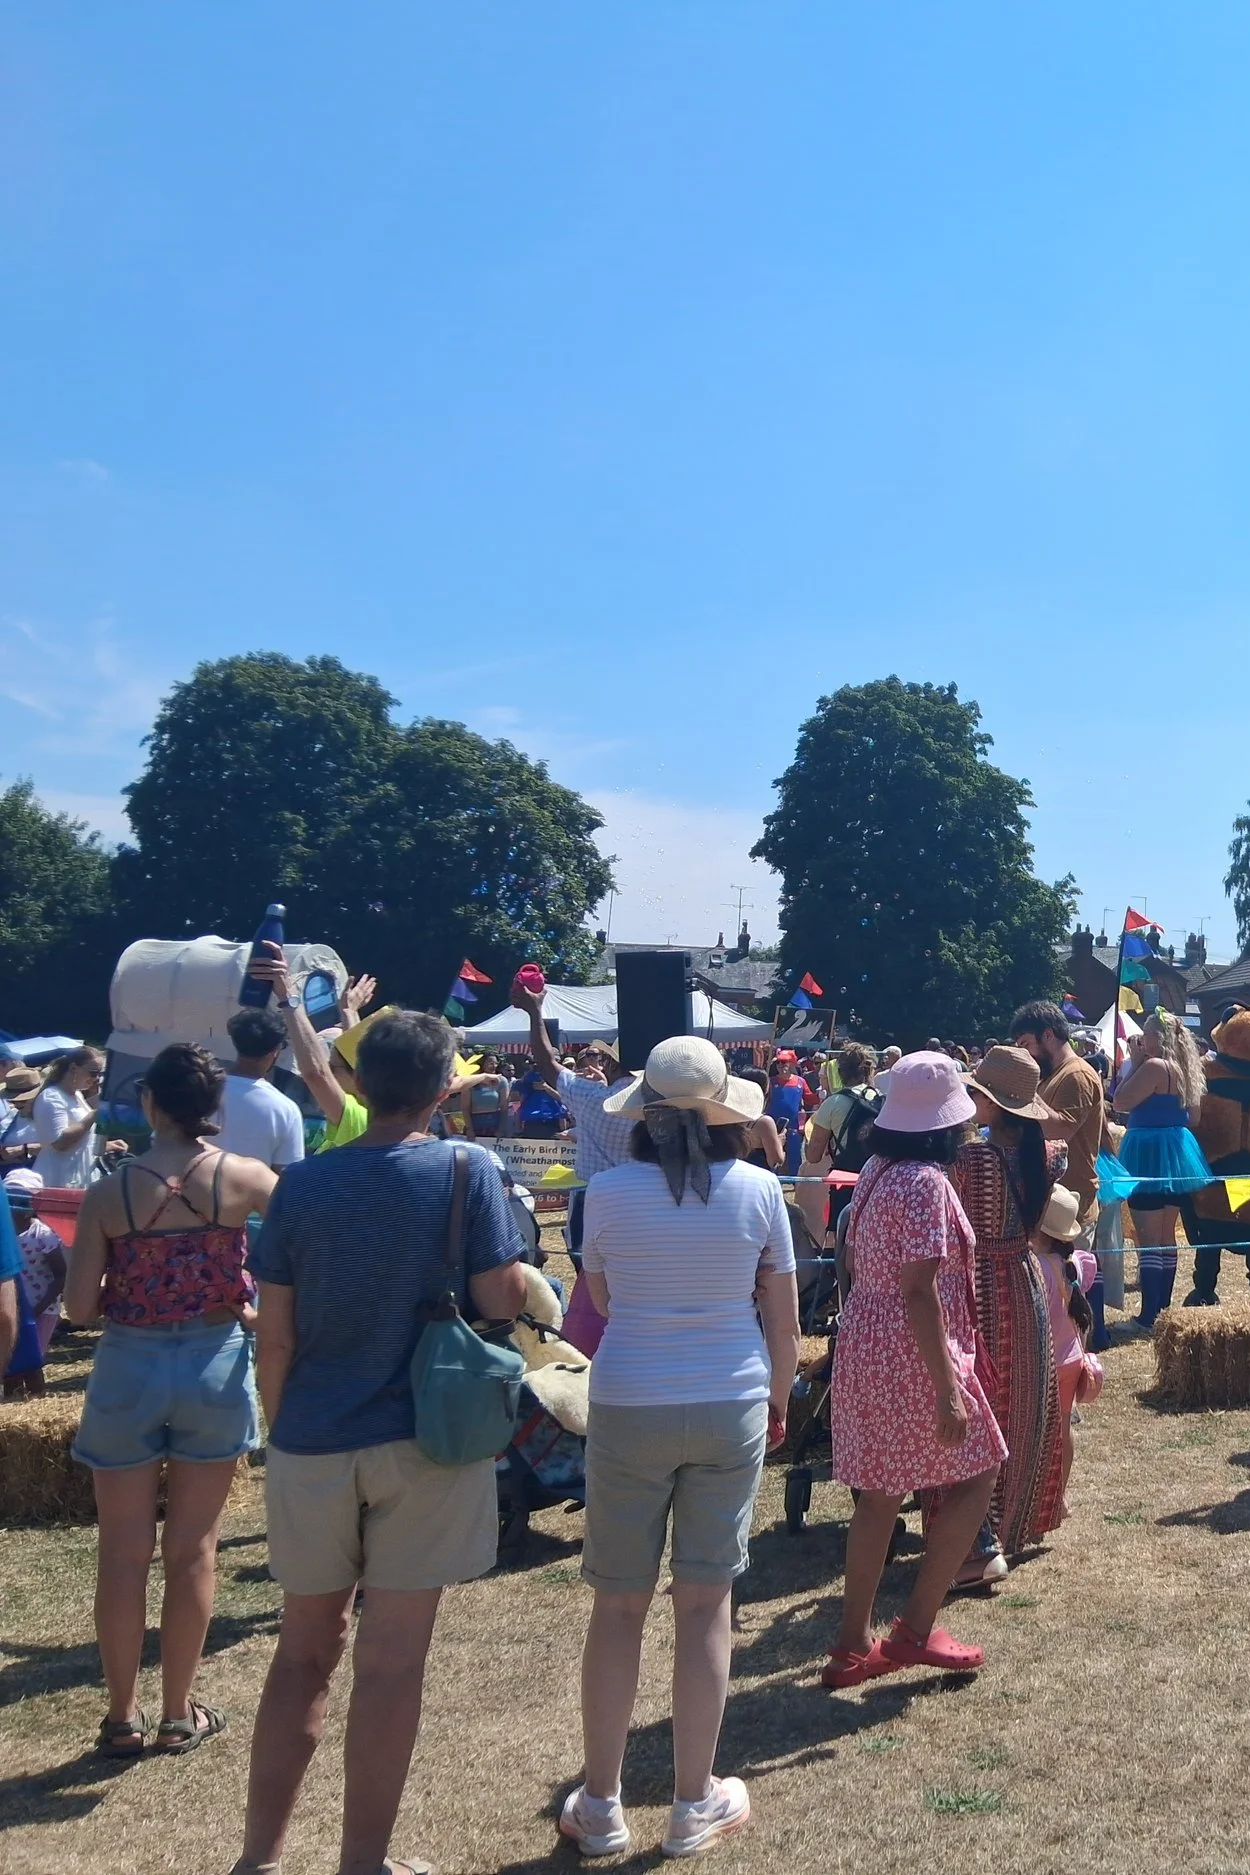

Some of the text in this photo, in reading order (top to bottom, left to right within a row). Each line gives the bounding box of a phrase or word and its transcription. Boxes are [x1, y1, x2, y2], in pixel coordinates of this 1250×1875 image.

[493, 1144, 577, 1155] The Early Bird Pre
[546, 1194, 557, 1202] to
